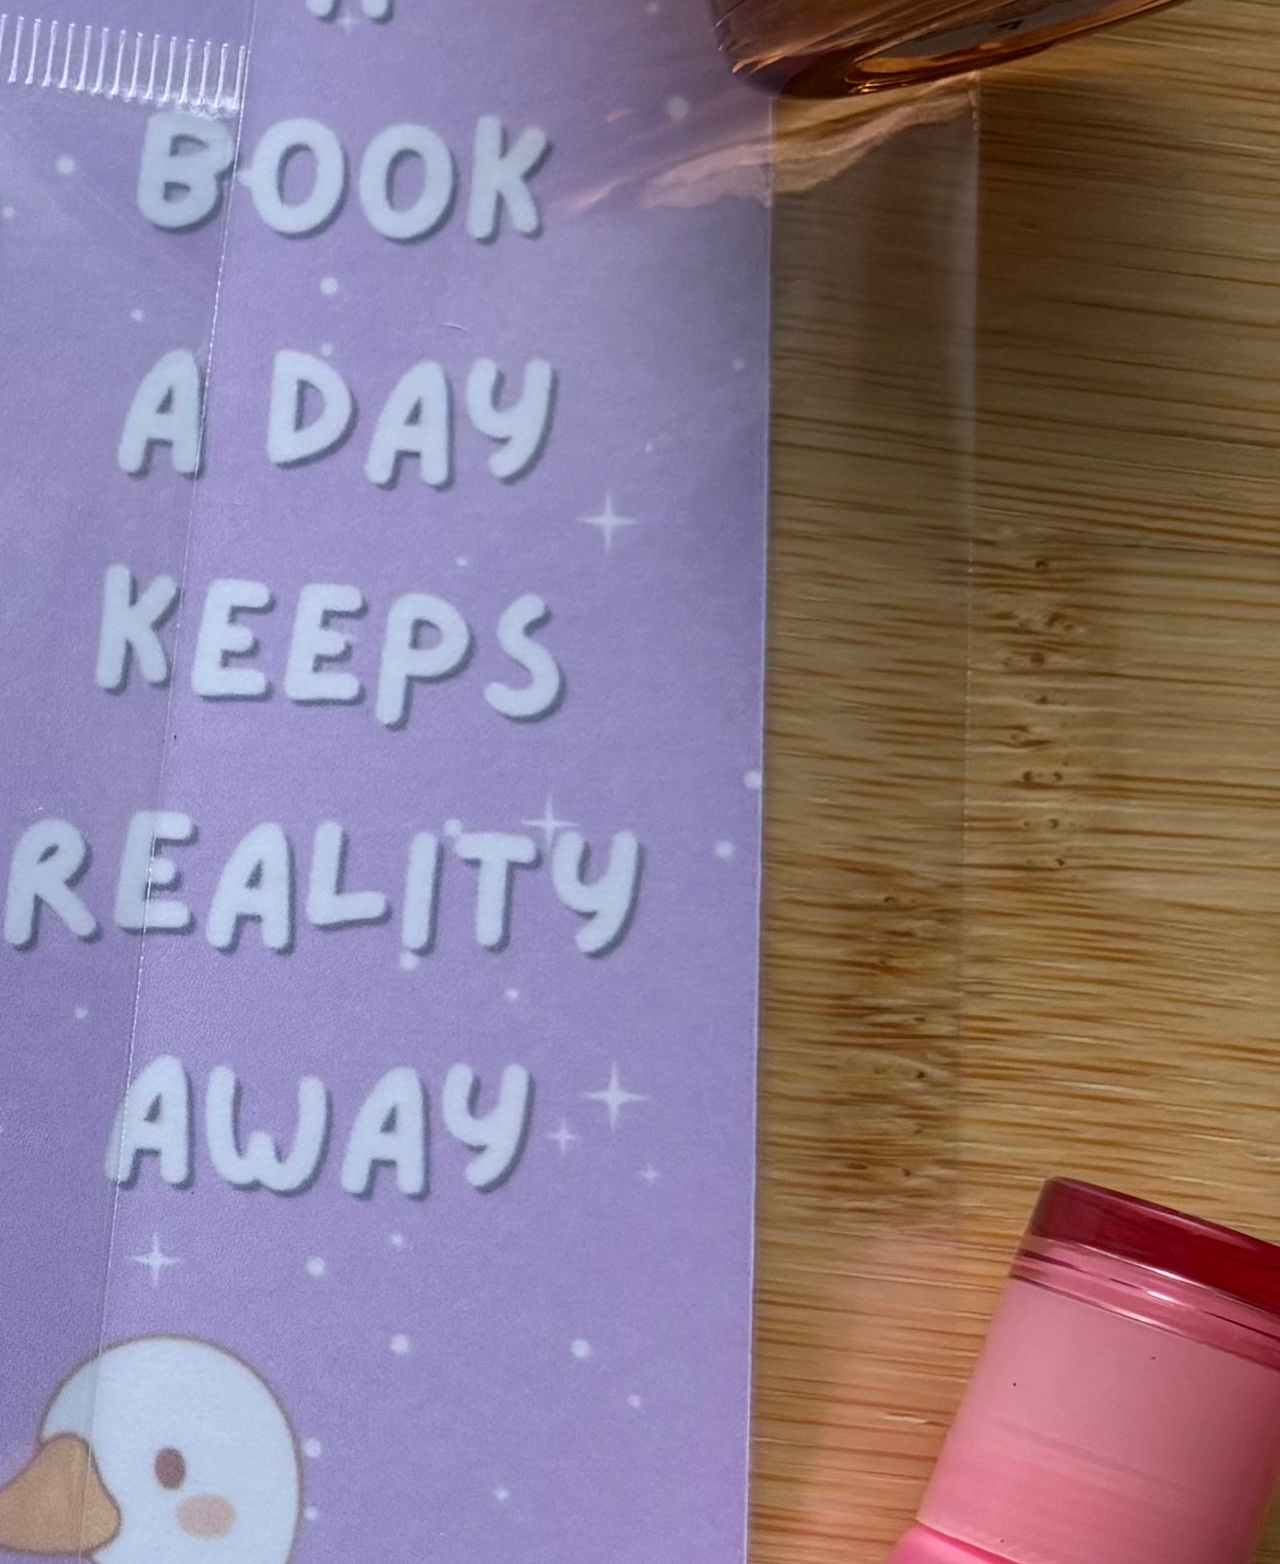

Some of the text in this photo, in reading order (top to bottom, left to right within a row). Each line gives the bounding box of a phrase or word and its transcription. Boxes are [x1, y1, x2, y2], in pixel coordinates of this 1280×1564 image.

[133, 109, 554, 246] BOOK
[116, 347, 559, 493] A DAY
[94, 562, 568, 730] KEEPS
[1, 810, 643, 958] REALITY
[105, 1056, 535, 1200] AWAY
